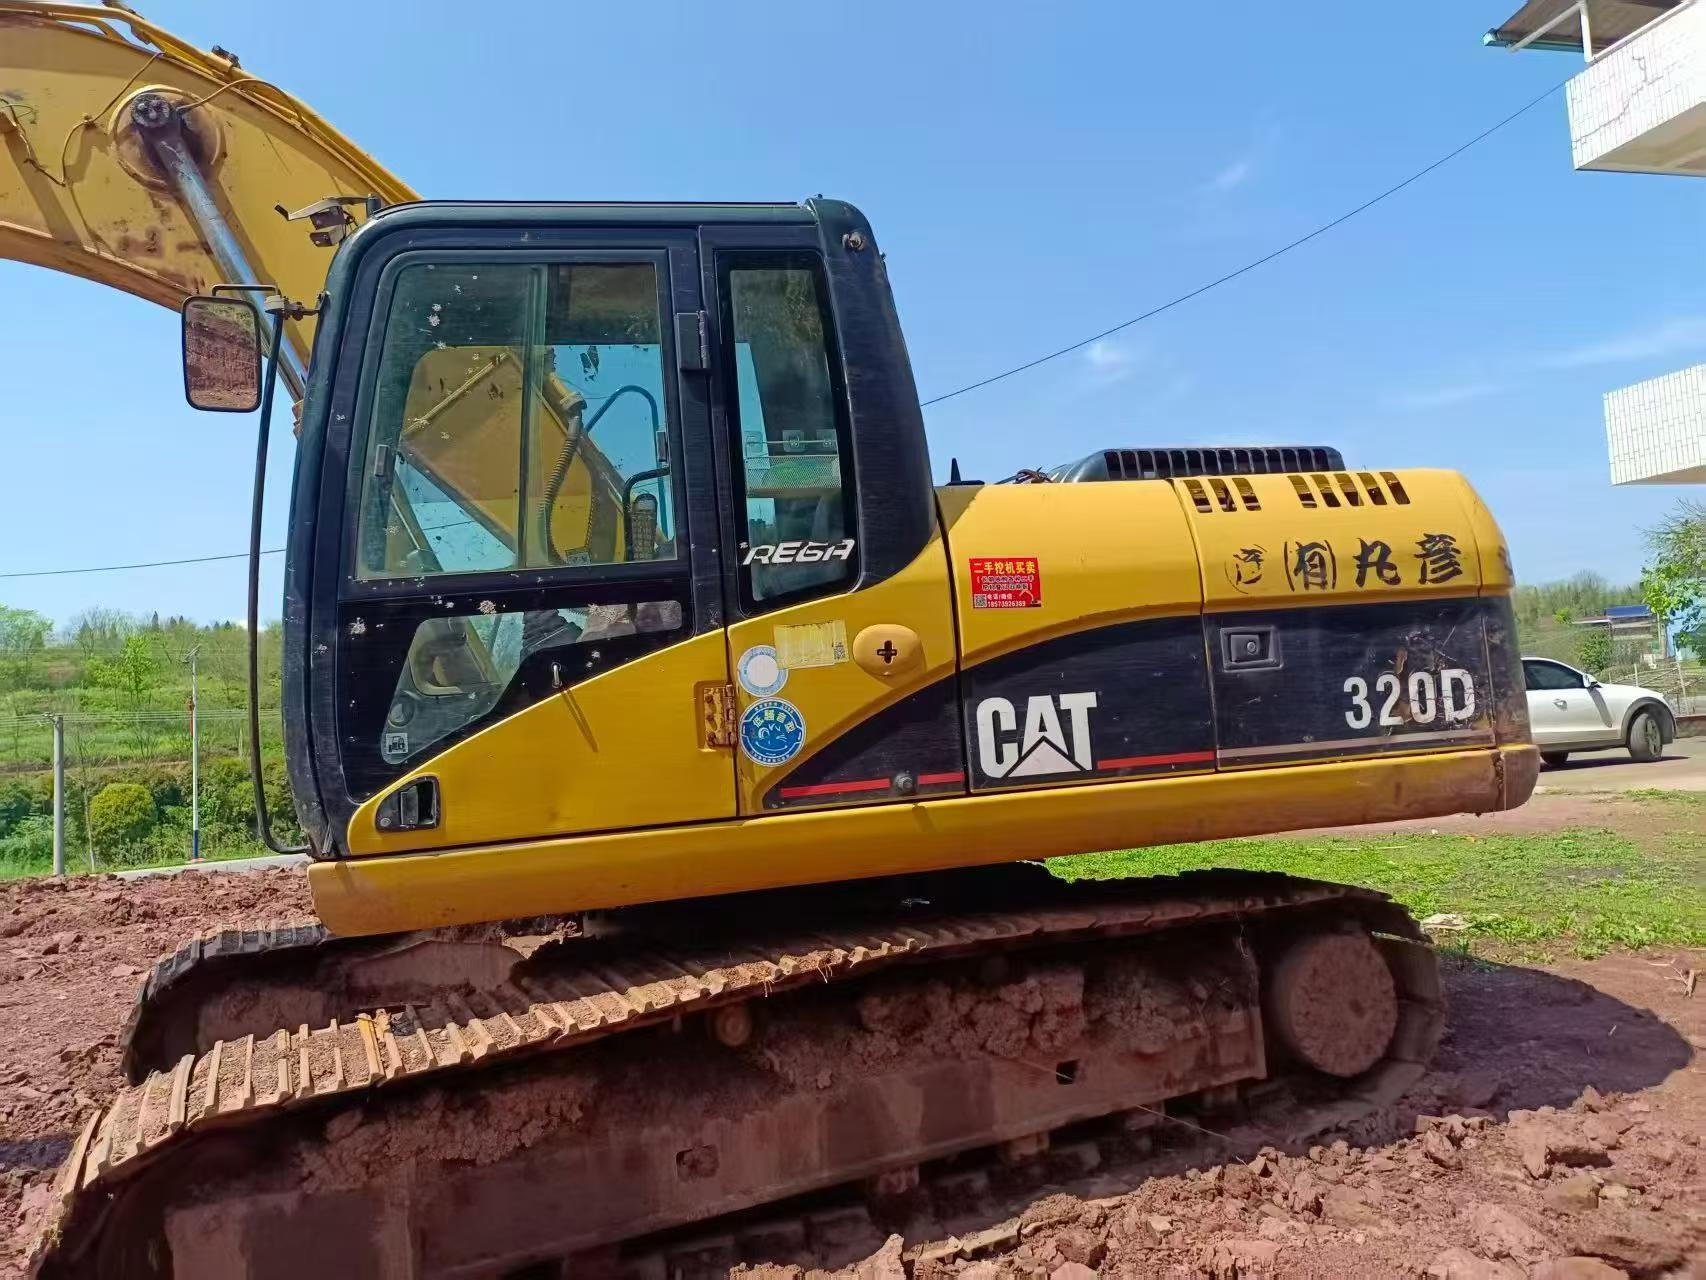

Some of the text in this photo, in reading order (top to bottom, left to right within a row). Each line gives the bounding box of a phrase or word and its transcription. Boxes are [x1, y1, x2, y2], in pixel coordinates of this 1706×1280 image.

[974, 561, 1036, 575] 二手挖机买卖
[1343, 668, 1476, 730] 320D
[976, 691, 1098, 778] CAT
